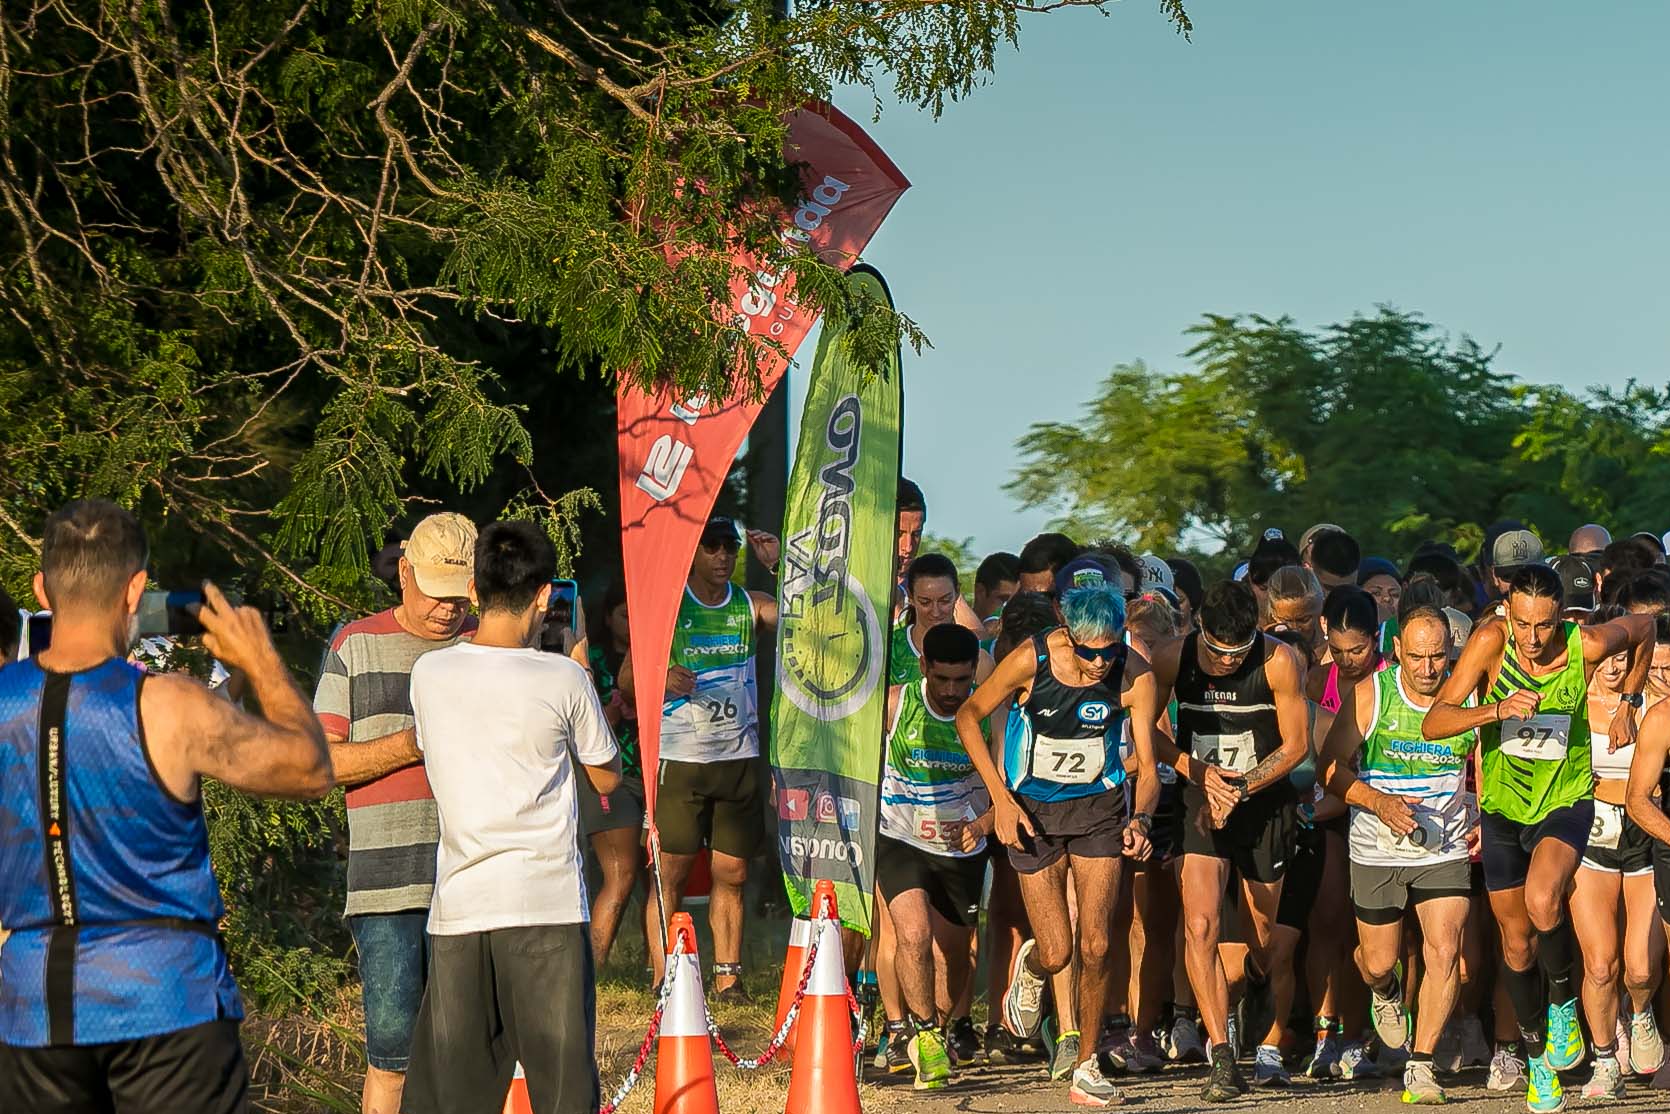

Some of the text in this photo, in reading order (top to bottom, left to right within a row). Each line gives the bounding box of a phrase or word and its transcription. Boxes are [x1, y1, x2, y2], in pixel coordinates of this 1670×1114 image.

[707, 698, 737, 722] 26
[1517, 727, 1553, 748] 97
[1203, 747, 1239, 767] 47
[1391, 740, 1453, 757] FIGHIERA
[1052, 752, 1085, 773] 72
